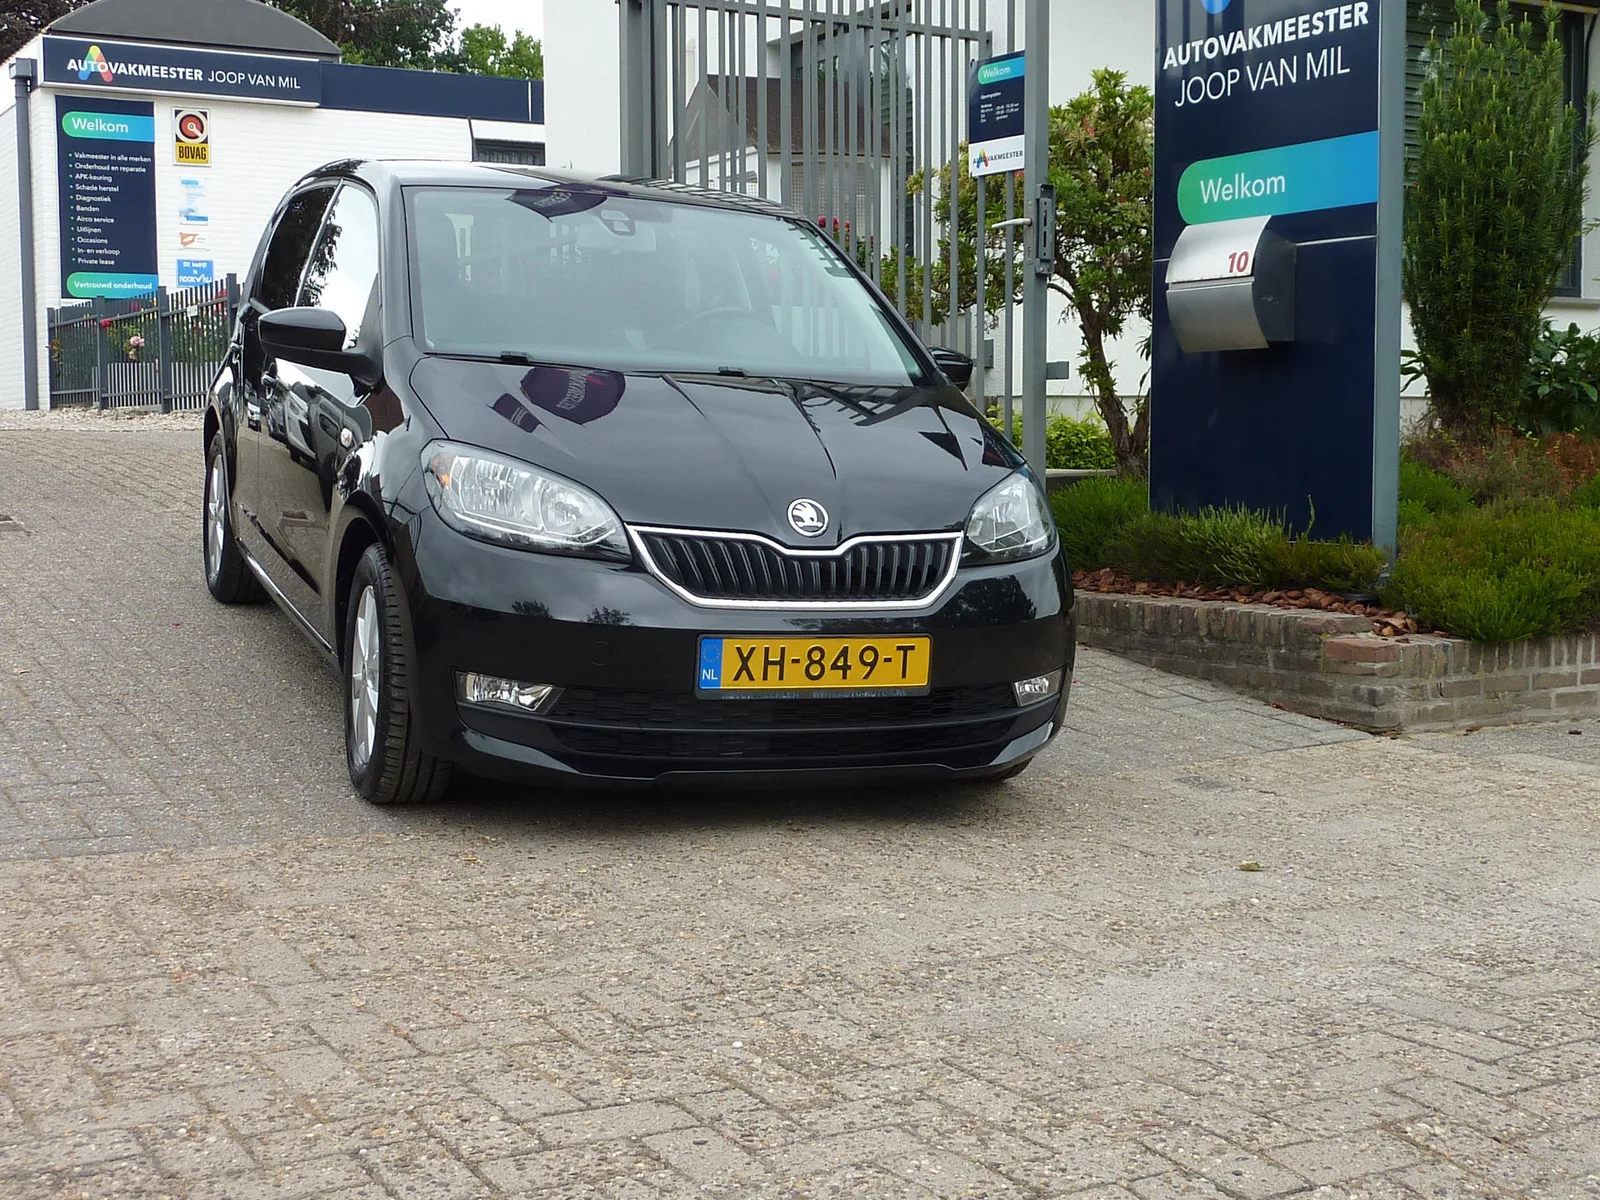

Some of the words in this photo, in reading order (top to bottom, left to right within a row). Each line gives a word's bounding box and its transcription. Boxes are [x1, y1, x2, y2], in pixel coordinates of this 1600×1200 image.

[1163, 1, 1369, 70] AUTOVAKMEESTER
[66, 58, 203, 82] AUTOVAKMEESTER
[208, 70, 245, 84] JOOP
[248, 73, 276, 87] VAN
[278, 76, 300, 89] MIL
[982, 66, 1011, 78] Welkom
[1175, 68, 1240, 107] JOOP
[1246, 55, 1298, 92] VAN
[1306, 46, 1350, 80] MIL
[71, 117, 129, 133] Welkom
[74, 152, 109, 160] Vakmeester
[178, 145, 207, 160] BOVAG
[74, 162, 110, 171] Onderhoud
[75, 173, 112, 182] APK-keuring
[98, 184, 119, 192] herstel
[1200, 173, 1286, 204] Welkom
[75, 194, 111, 202] Diagnostiek
[76, 236, 108, 244] Occasions
[95, 248, 120, 256] verkoop
[1228, 251, 1249, 274] 10
[73, 281, 112, 289] Vertrouwd
[113, 281, 153, 290] onderhoud
[702, 668, 718, 680] NL
[732, 645, 916, 682] XH-849-T
